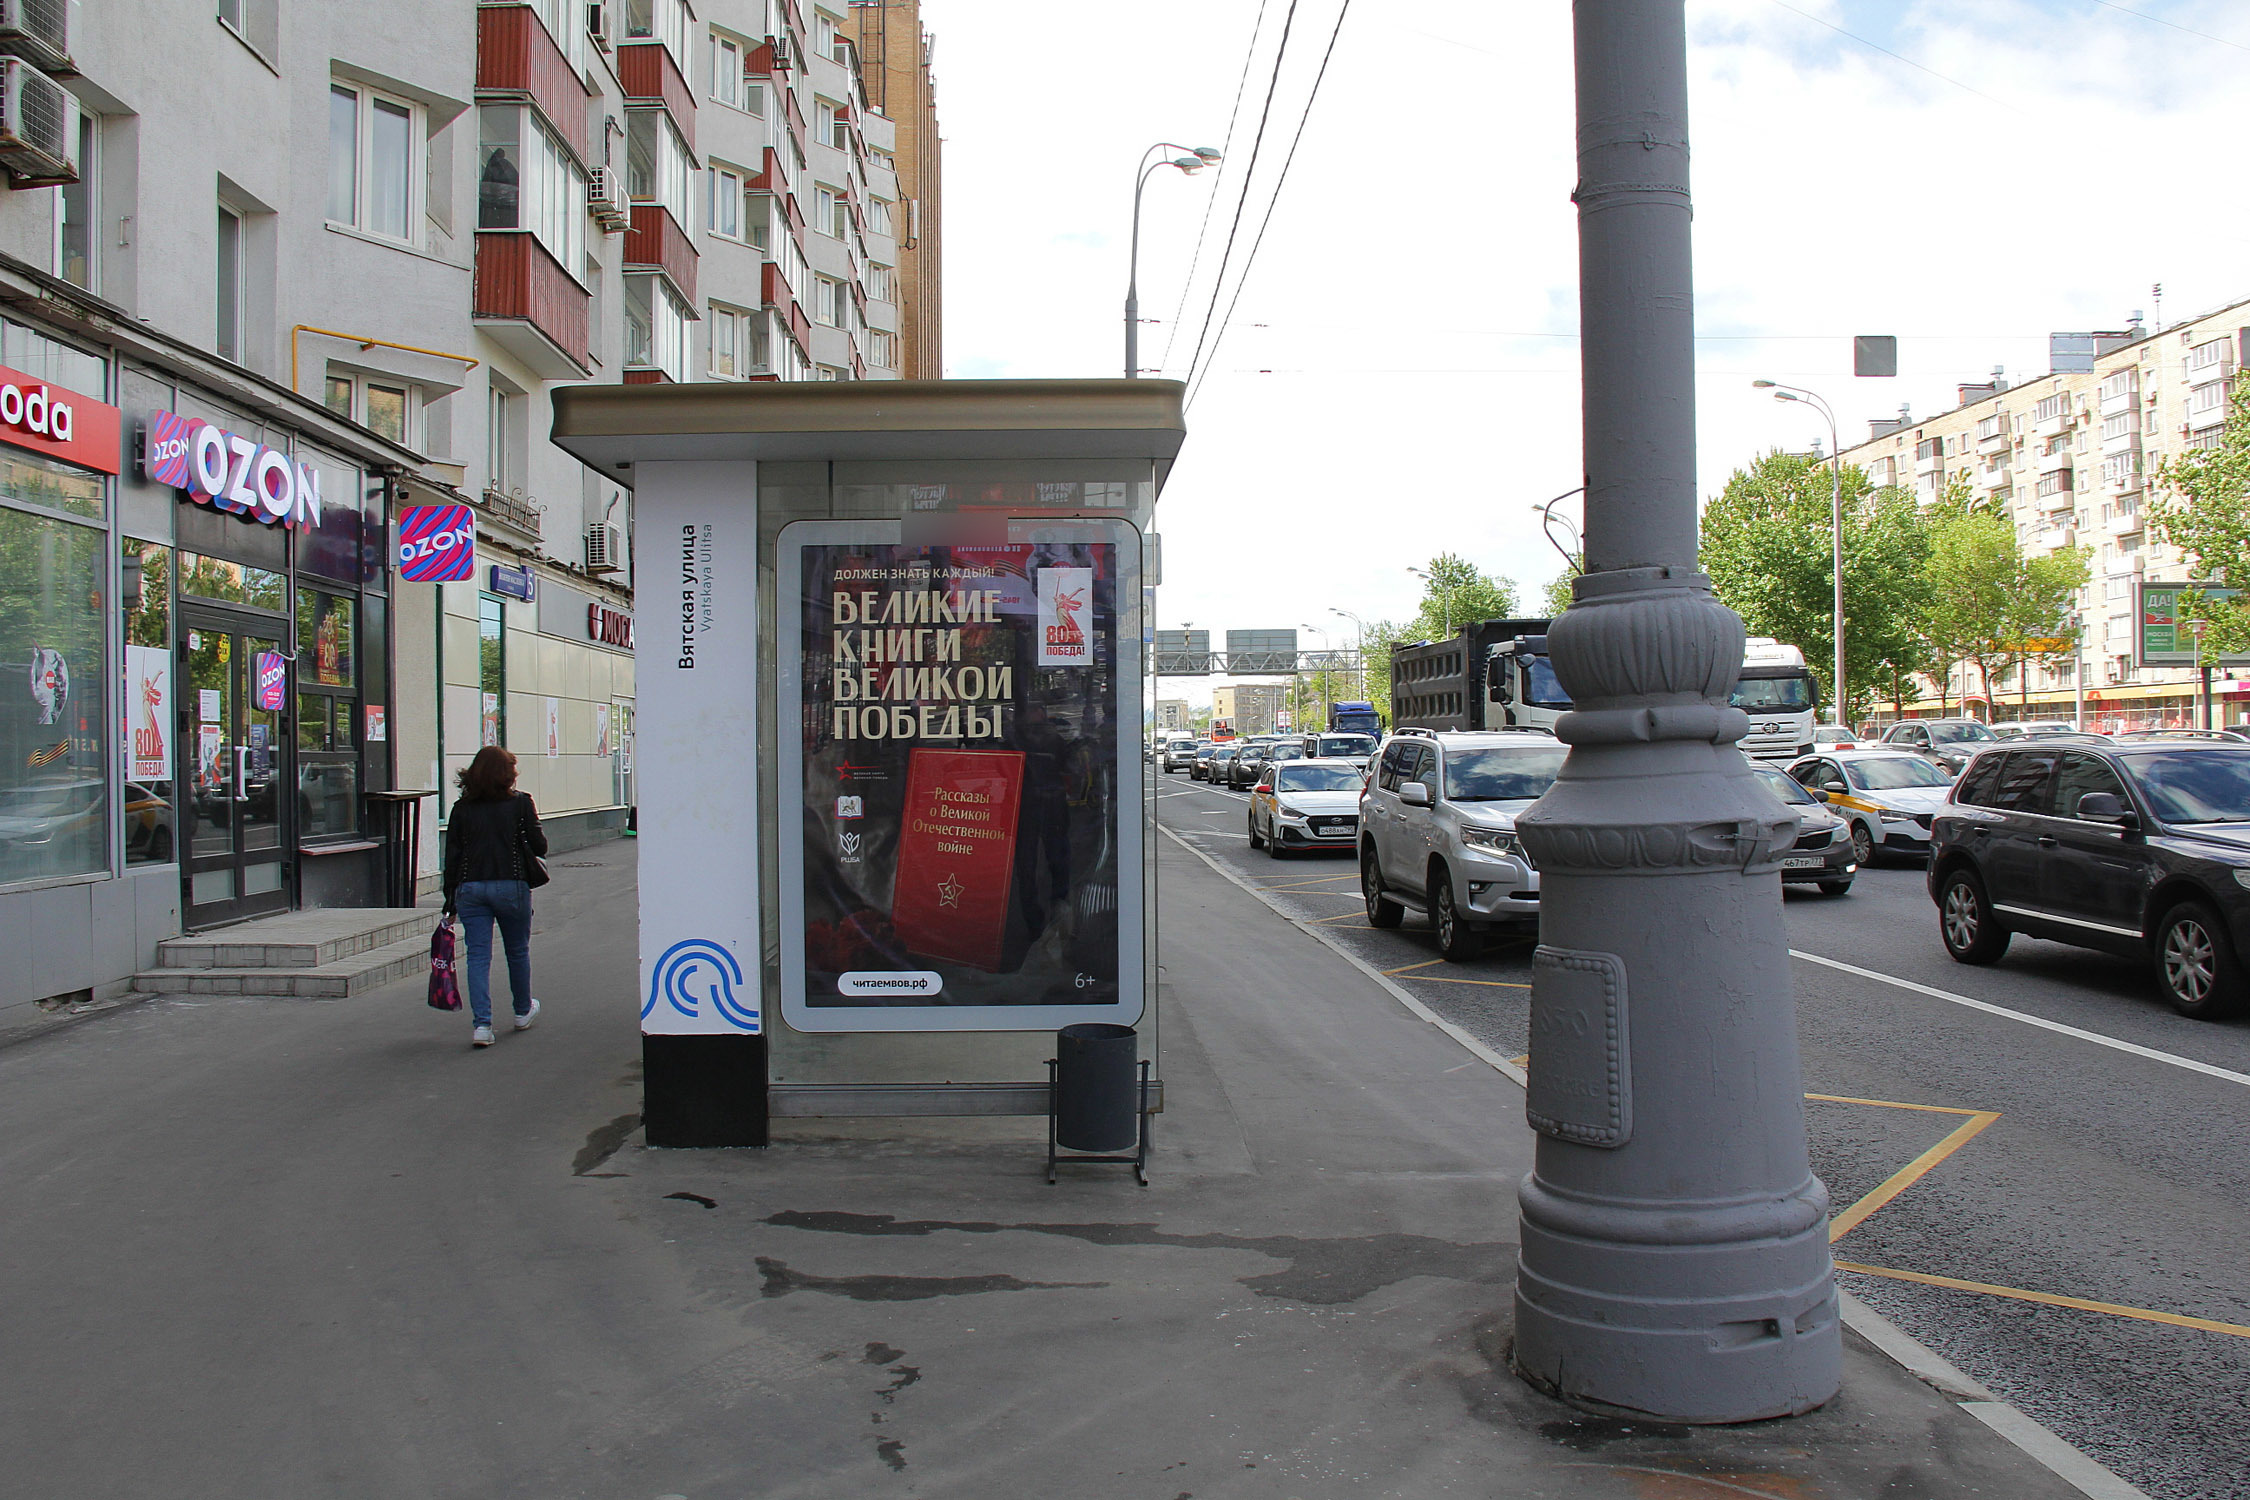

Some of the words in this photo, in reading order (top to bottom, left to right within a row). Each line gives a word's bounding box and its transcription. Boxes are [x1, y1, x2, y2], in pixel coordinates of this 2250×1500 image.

[197, 424, 321, 528] OZON
[400, 524, 474, 562] OZON
[682, 525, 699, 585] улица
[700, 524, 712, 563] Ulitsa
[528, 572, 534, 596] 5
[834, 569, 887, 581] ДОЛЖЕН
[891, 568, 930, 578] ЗНАТЬ
[933, 566, 995, 579] КАЖДЫЙ!
[700, 567, 714, 632] Vyatskaya
[833, 590, 1002, 625] ВЕЛИКИЕ
[2147, 594, 2172, 609] ДА!
[678, 590, 695, 669] Вятская
[1046, 625, 1068, 644] 80
[833, 629, 961, 663] КНИГИ
[1045, 646, 1085, 656] ПОБЕДА!
[261, 663, 286, 688] OZON
[833, 661, 1012, 701] ВЕЛИКОЙ
[833, 705, 1002, 740] ПОБЕДЫ
[136, 728, 153, 756] 80
[136, 761, 165, 778] ПОБЕДА!
[935, 787, 990, 804] Рассказы
[930, 807, 937, 817] о
[940, 804, 990, 822] Великой
[913, 818, 1005, 841] Отечественной
[937, 840, 973, 855] войне
[852, 978, 928, 990] читаемвов.рф
[1074, 972, 1096, 988] 6+
